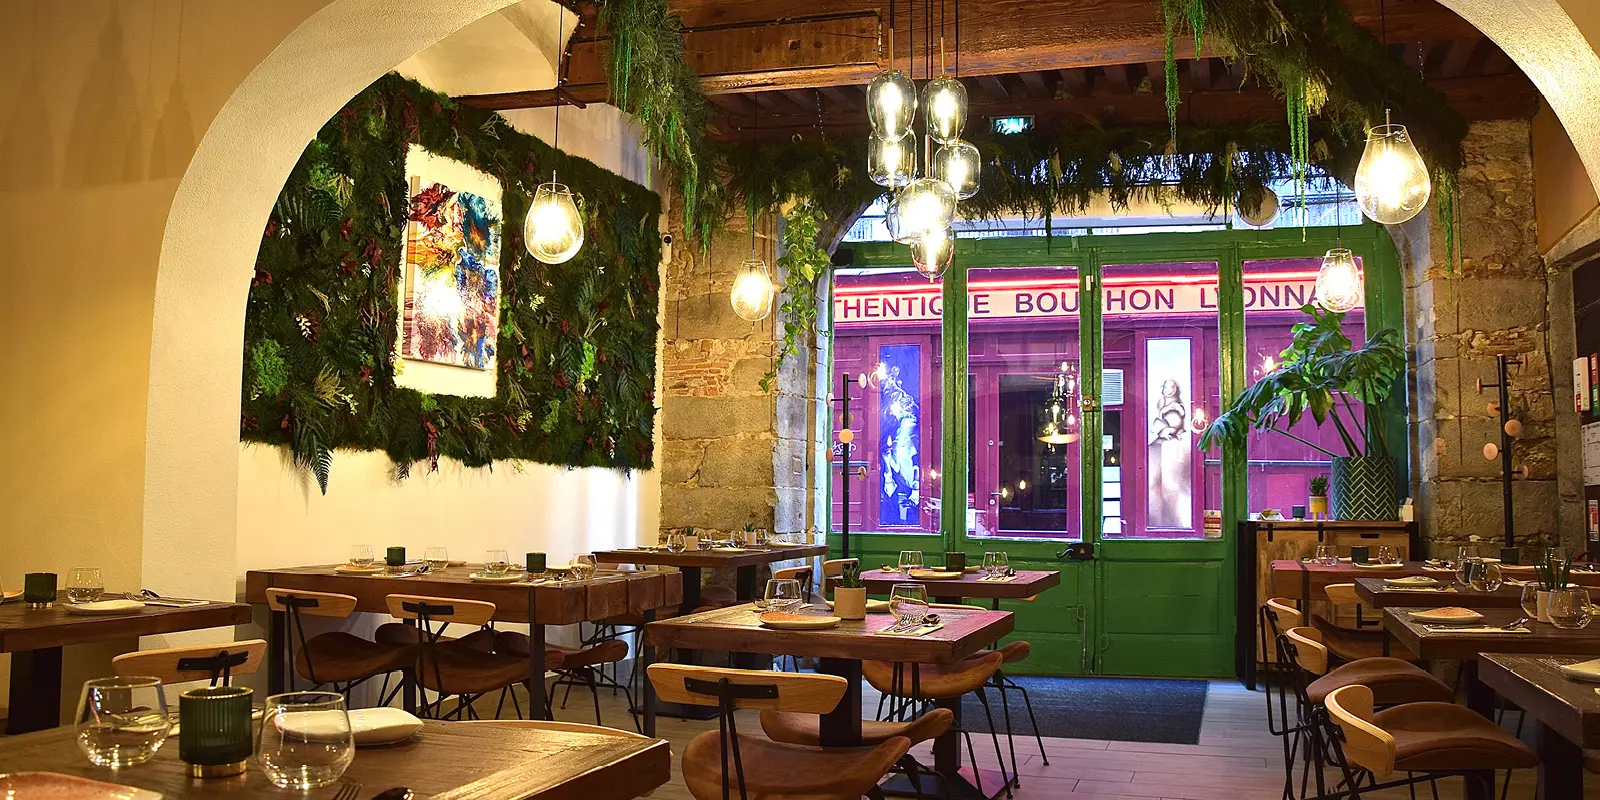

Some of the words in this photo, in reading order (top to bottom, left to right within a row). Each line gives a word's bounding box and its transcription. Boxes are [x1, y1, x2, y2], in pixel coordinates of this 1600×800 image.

[834, 294, 990, 318] HENTIQE
[1015, 288, 1174, 314] BOUHON
[1200, 284, 1318, 309] LONN
